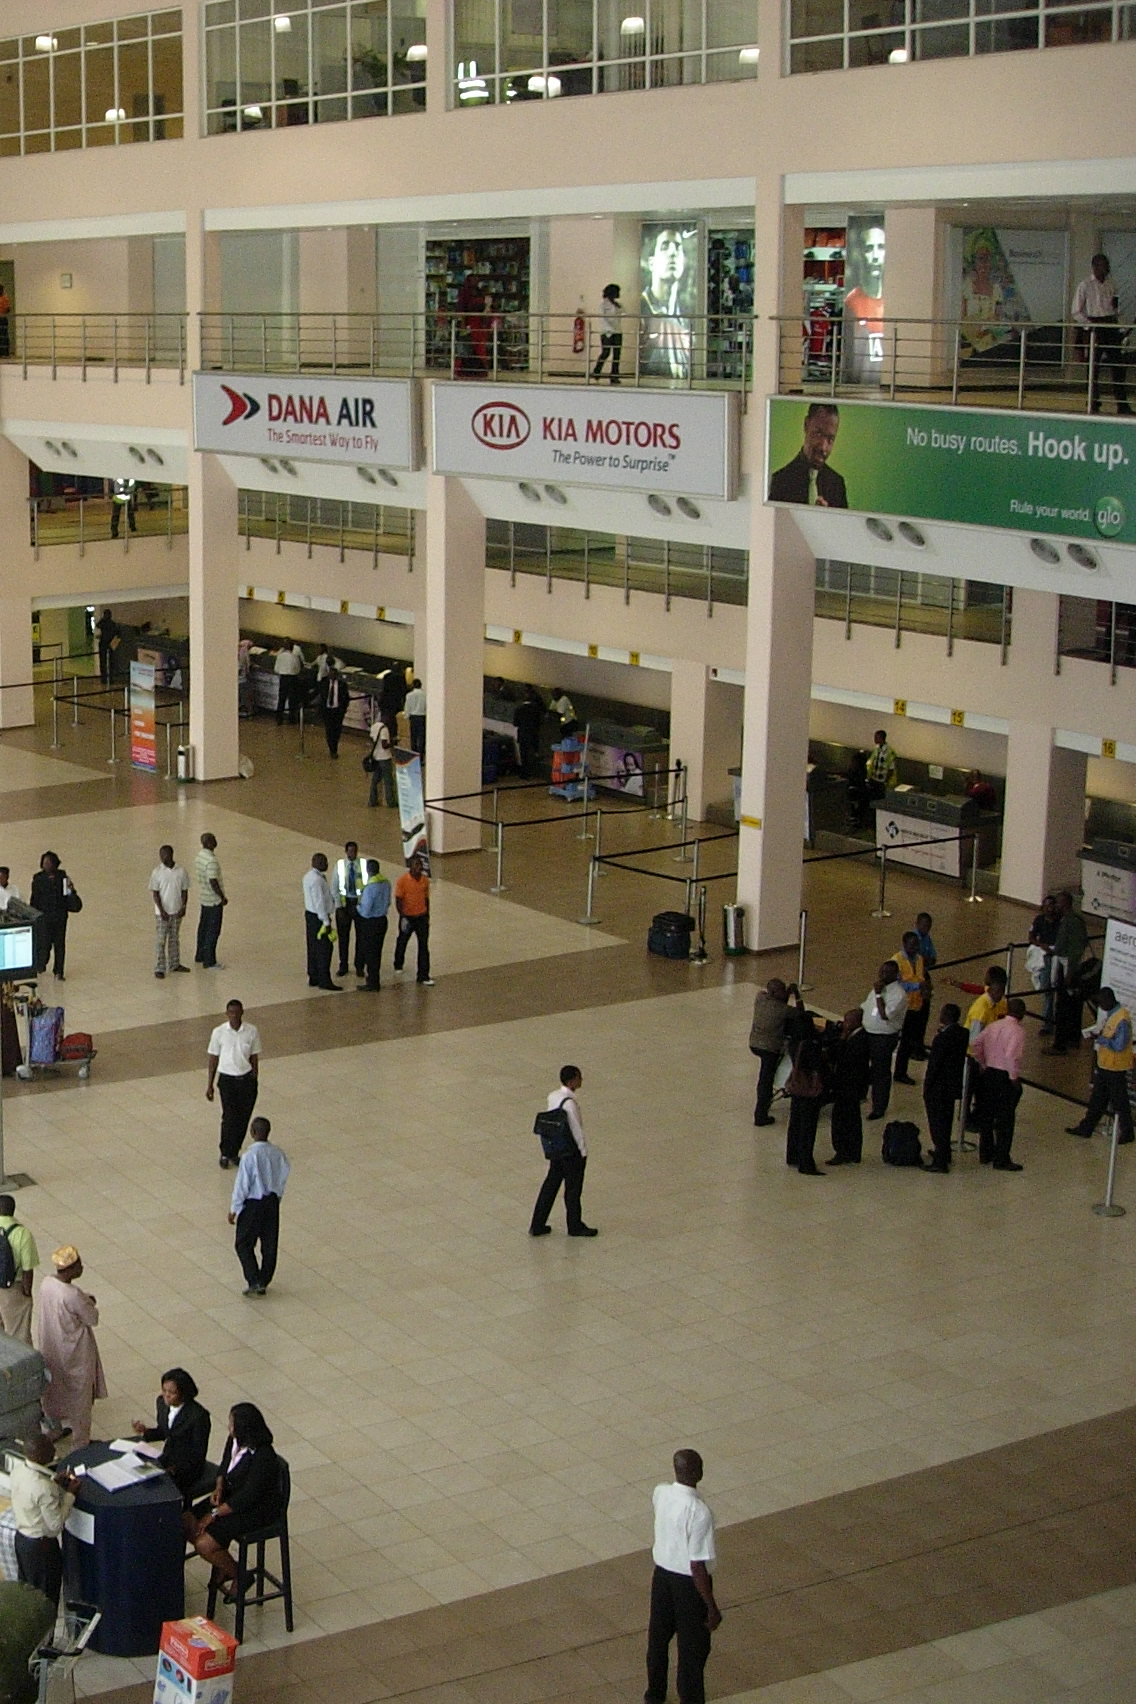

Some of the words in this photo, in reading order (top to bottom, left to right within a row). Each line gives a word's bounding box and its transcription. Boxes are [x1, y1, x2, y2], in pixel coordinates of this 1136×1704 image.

[267, 393, 331, 426] DANA
[337, 397, 377, 428] AIR
[481, 413, 521, 439] KIA
[542, 416, 578, 442] KIA
[585, 419, 681, 450] MOTORS
[267, 428, 284, 443] The
[285, 429, 327, 447] Smartest
[329, 432, 350, 452] Way
[351, 435, 363, 449] to
[364, 434, 379, 452] Fly
[906, 427, 928, 447] No
[931, 429, 966, 455] busy
[970, 435, 1022, 456] routes.
[1027, 431, 1087, 461] Hook
[1093, 442, 1130, 471] up.
[552, 449, 572, 464] The
[573, 451, 607, 468] Power
[609, 454, 621, 468] to
[1009, 498, 1033, 515] Rule
[1034, 506, 1059, 519] your
[1097, 506, 1121, 529] glo
[895, 701, 905, 713] 14
[952, 711, 963, 724] 15
[1103, 741, 1114, 754] 16
